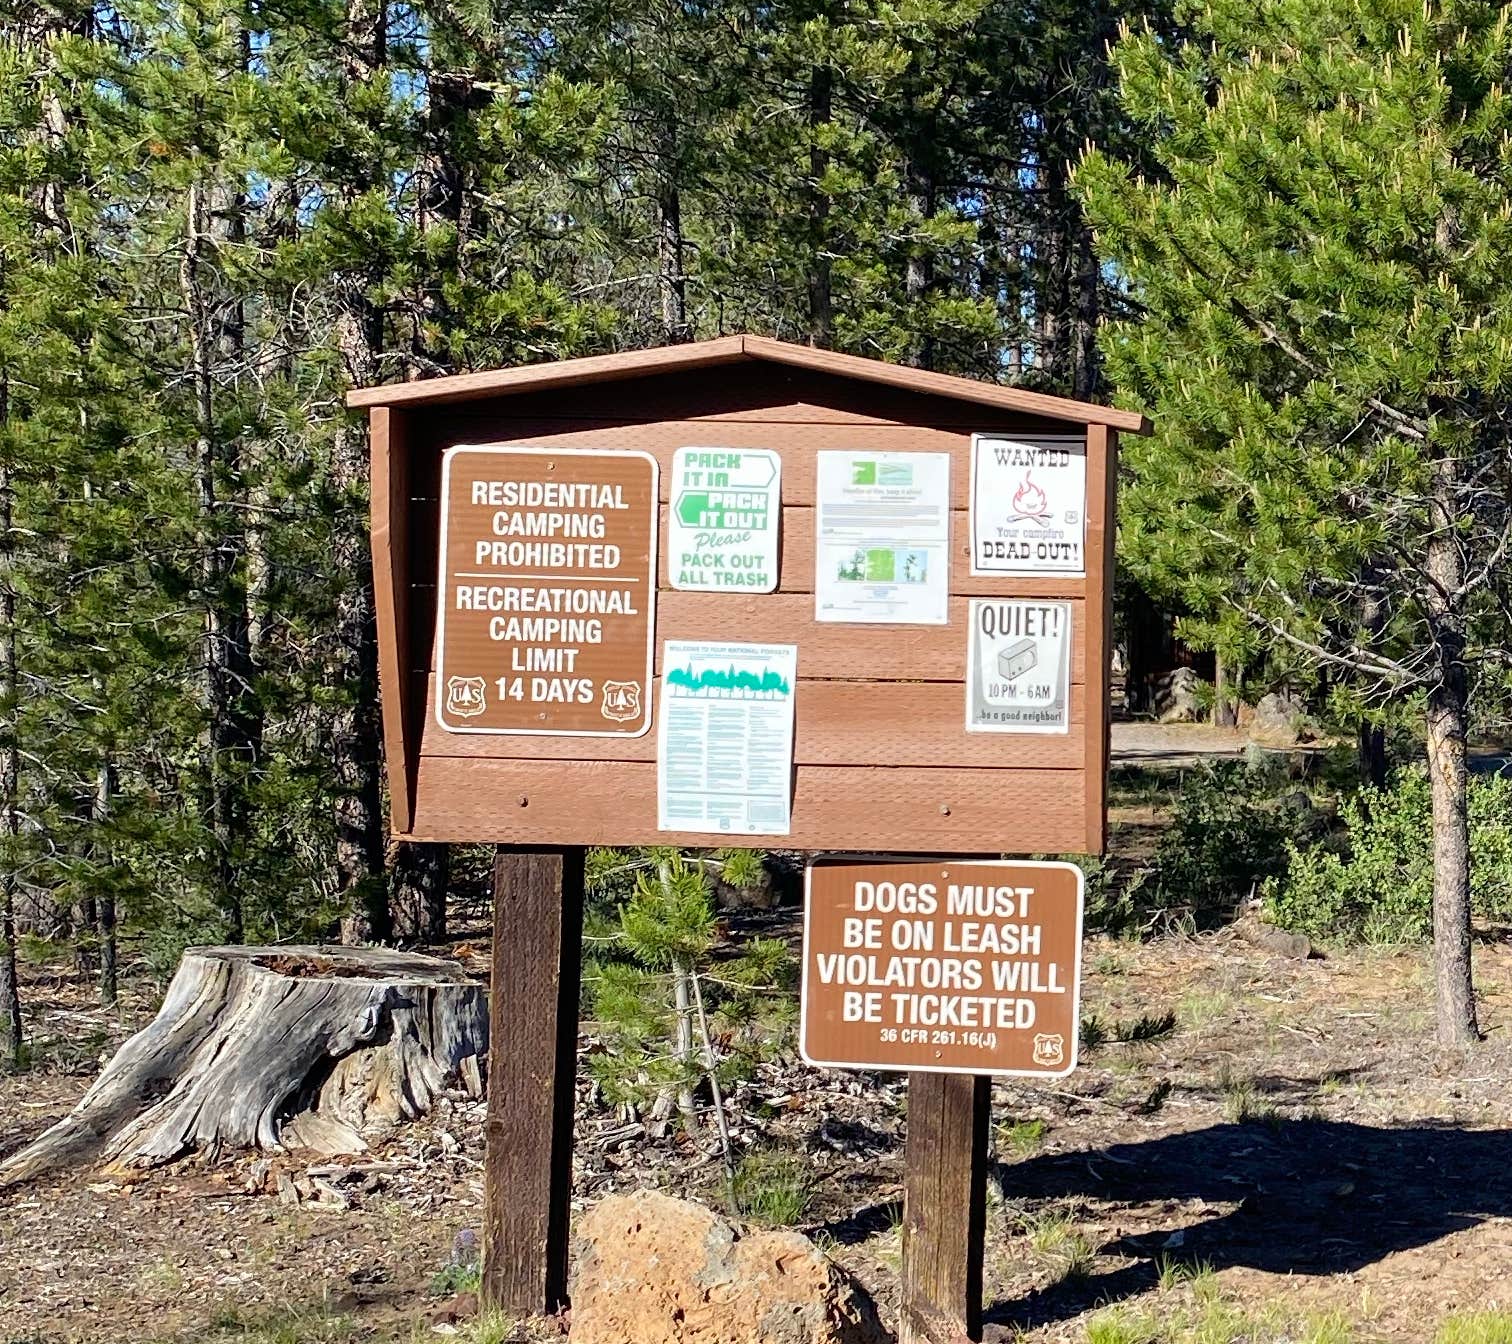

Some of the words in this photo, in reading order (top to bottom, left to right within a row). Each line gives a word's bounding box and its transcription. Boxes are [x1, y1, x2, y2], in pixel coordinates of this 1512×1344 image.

[684, 453, 742, 469] PACK
[993, 447, 1070, 468] WANTED
[683, 471, 703, 487] IT
[707, 471, 729, 488] IN
[472, 481, 629, 509] RESIDENTIAL
[708, 492, 767, 510] PACK
[492, 511, 606, 538] CAMPING
[699, 511, 720, 528] IT
[723, 512, 767, 529] OUT
[693, 531, 752, 552] Please
[995, 527, 1019, 539] Your
[1022, 528, 1065, 541] campfire
[475, 541, 621, 569] PROHIBITED
[681, 553, 725, 568] PACK
[730, 555, 765, 570] OUT
[982, 541, 1031, 560] DEAD
[1037, 542, 1079, 561] OUT!
[678, 570, 708, 585] ALL
[713, 572, 768, 587] TRASH
[456, 585, 638, 615] RECREATIONAL
[489, 617, 602, 644] CAMPING
[981, 605, 1059, 640] QUIET!
[512, 647, 579, 673] LIMIT
[495, 677, 524, 701] 14
[531, 678, 594, 704] DAYS
[1001, 711, 1021, 722] good
[1022, 711, 1062, 723] neighbor!
[854, 881, 938, 915] DOGS
[946, 884, 1035, 918] MUST
[843, 918, 883, 949] BE
[891, 920, 934, 951] ON
[943, 921, 1042, 956] LEASH
[816, 953, 983, 991] VIOLATORS
[991, 960, 1066, 994] WILL
[842, 991, 882, 1023] BE
[891, 993, 1036, 1030] TICKETED
[880, 1028, 898, 1042] 36
[901, 1029, 928, 1044] CFR
[931, 1031, 998, 1049] 261.16(J)
